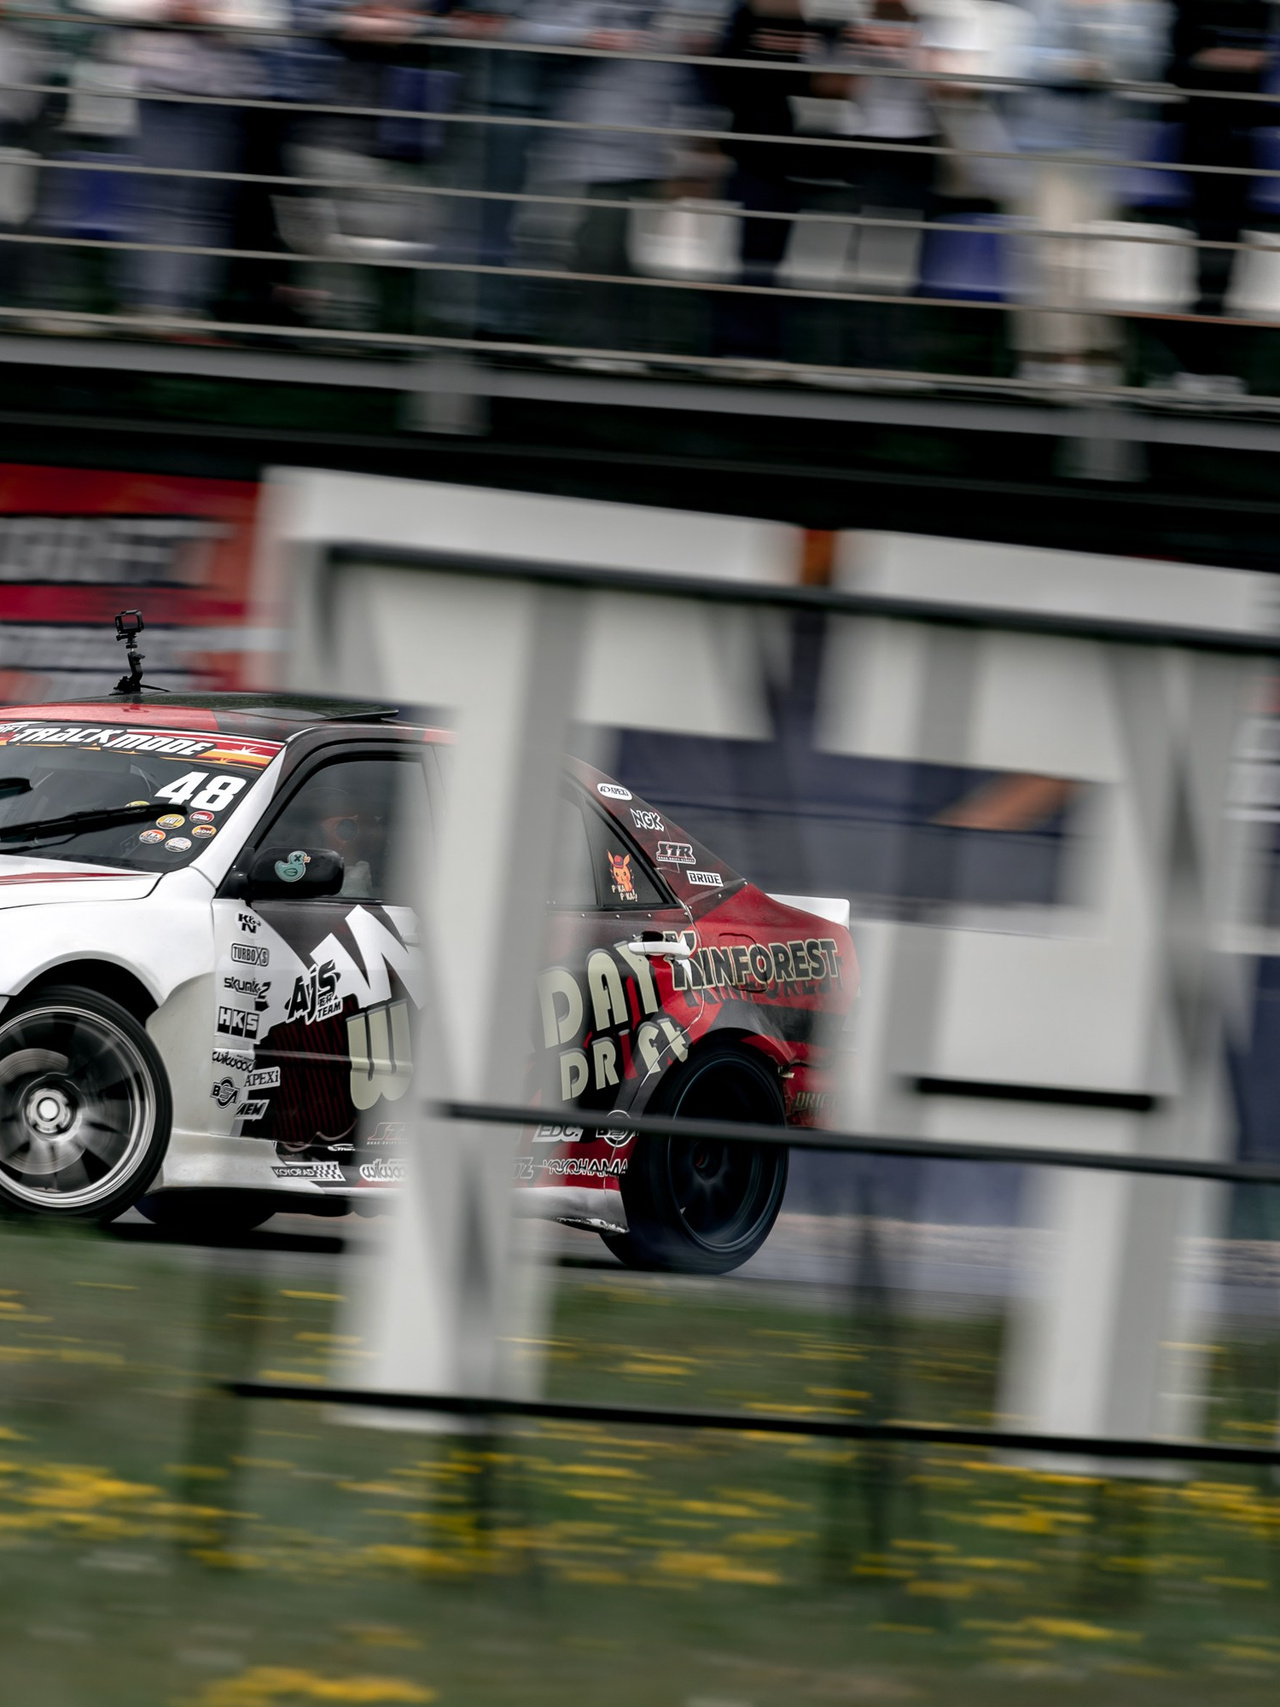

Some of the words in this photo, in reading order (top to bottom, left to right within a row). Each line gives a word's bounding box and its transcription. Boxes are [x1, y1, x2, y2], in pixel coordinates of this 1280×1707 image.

[153, 770, 247, 812] 48
[629, 808, 664, 832] NGK
[688, 872, 723, 885] BRIDE
[536, 940, 660, 1049] DAY
[218, 1007, 260, 1033] HKS
[317, 1000, 342, 1019] TEAM
[274, 1167, 316, 1177] KOYORAD
[360, 1159, 412, 1182] wilwoo
